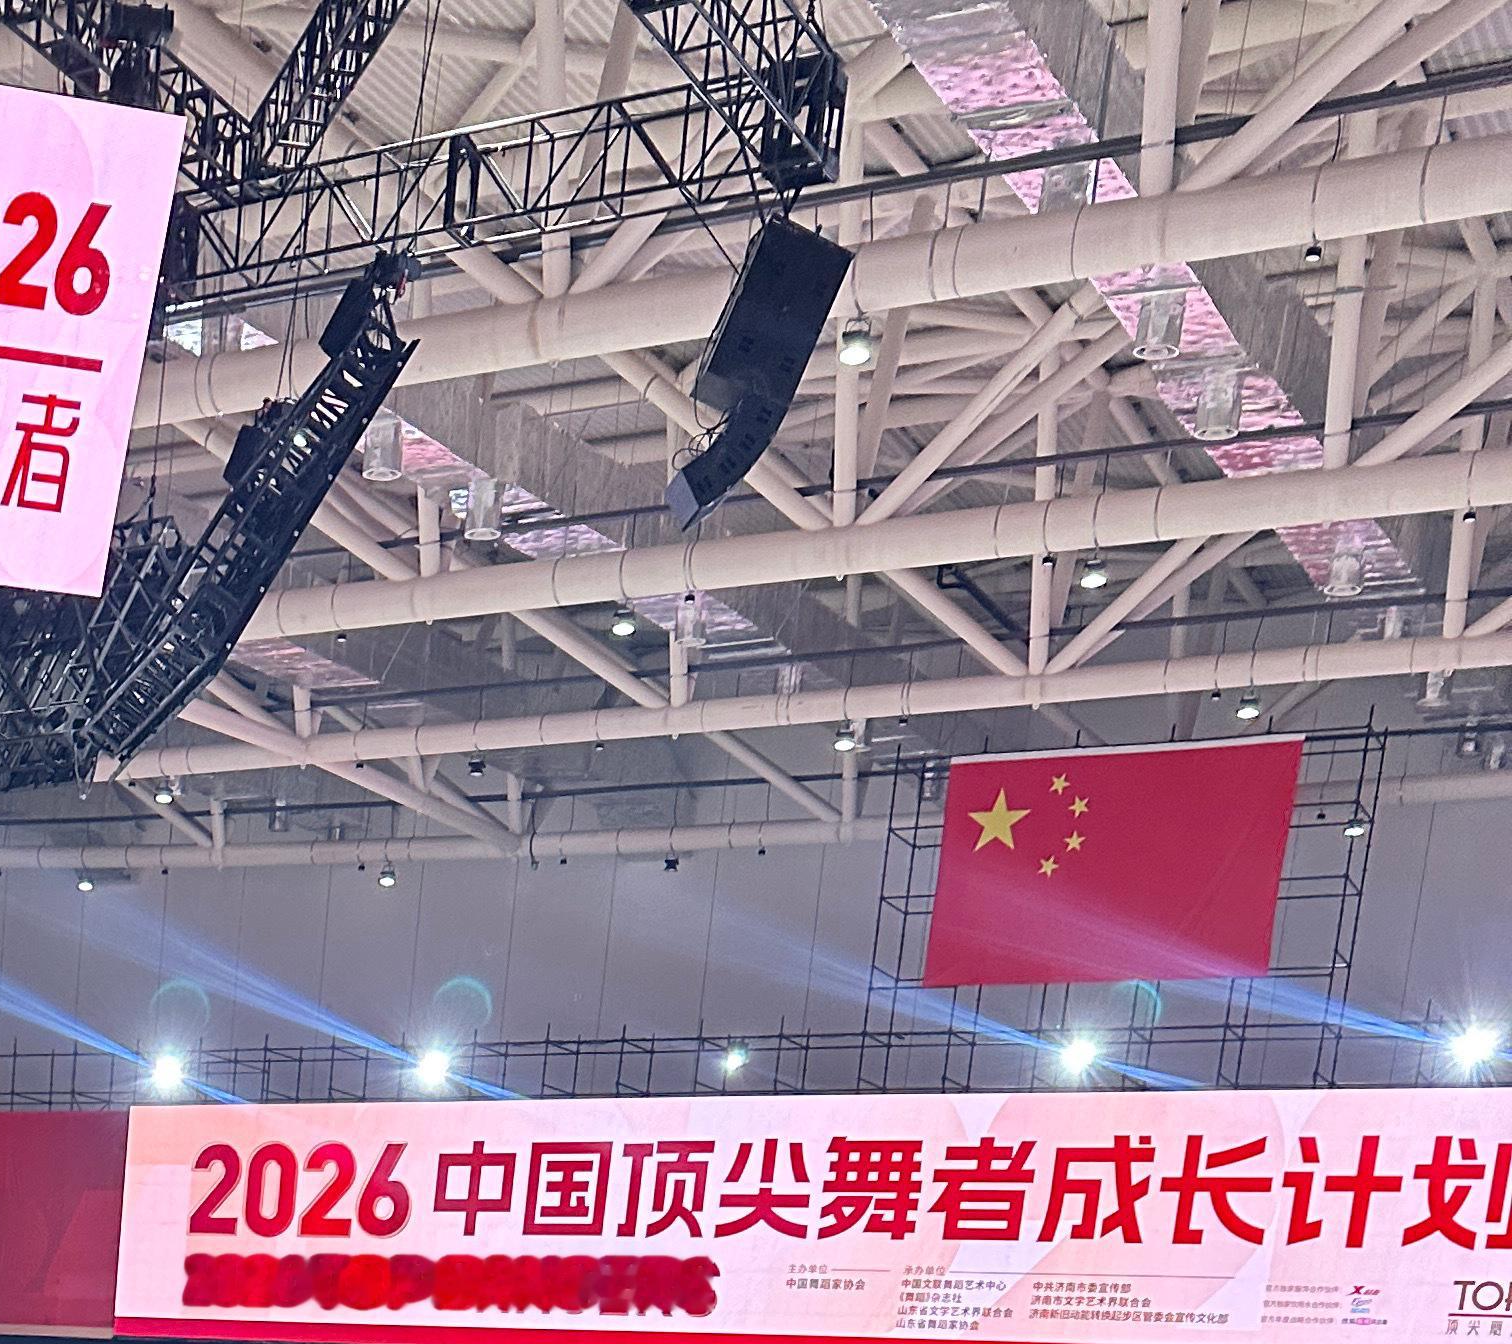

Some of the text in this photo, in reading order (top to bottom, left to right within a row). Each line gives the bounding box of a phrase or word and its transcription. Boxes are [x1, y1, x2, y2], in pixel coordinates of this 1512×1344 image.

[188, 1135, 1512, 1250] 2026 中国顶尖舞者成长计划
[788, 1263, 829, 1274] 主办单位
[903, 1264, 947, 1276] 承办单位
[786, 1278, 866, 1290] 中国舞蹈家协会
